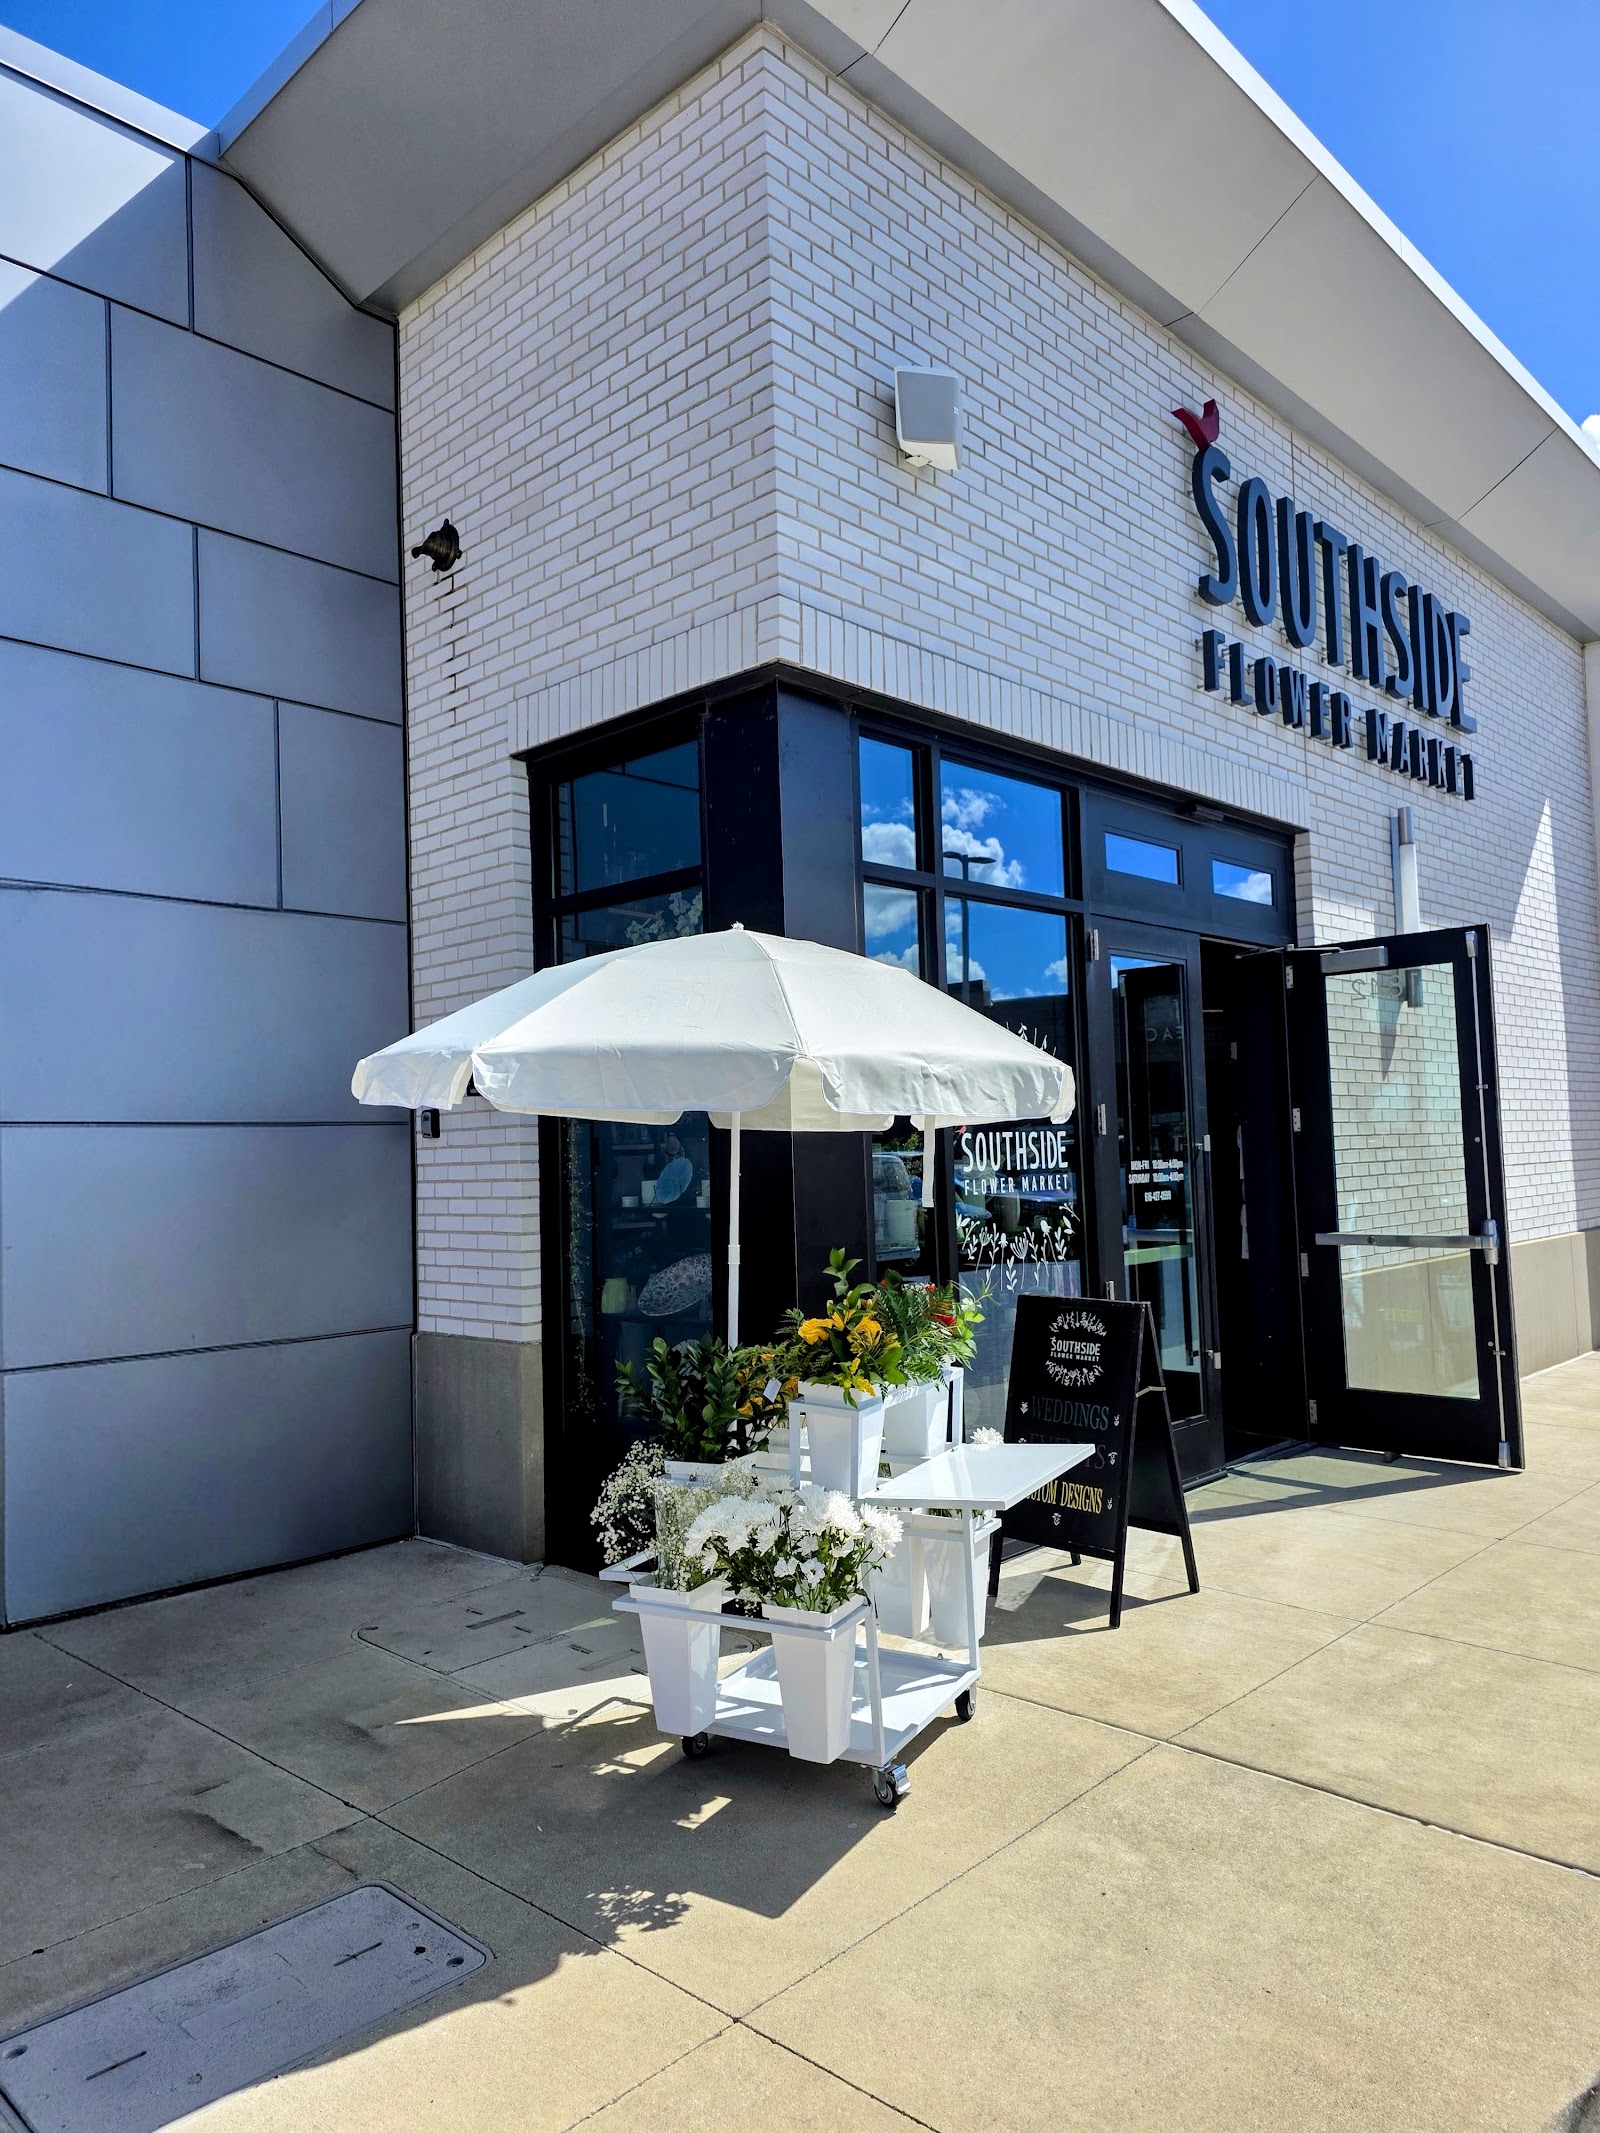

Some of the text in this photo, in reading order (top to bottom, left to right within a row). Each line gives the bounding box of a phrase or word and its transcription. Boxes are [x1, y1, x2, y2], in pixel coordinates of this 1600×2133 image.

[1192, 445, 1477, 734] SOUTHSIDE
[1202, 628, 1476, 801] FLOWER MARKET
[961, 1130, 1069, 1173] SOUTHSIDE
[964, 1174, 1069, 1196] FLOWER MARKET
[1050, 1339, 1101, 1356] SOUTHSIDE
[1050, 1351, 1100, 1362] FLOWER MARKET
[1032, 1395, 1109, 1431] WEDDINGS
[1060, 1481, 1103, 1514] DESIGNS
